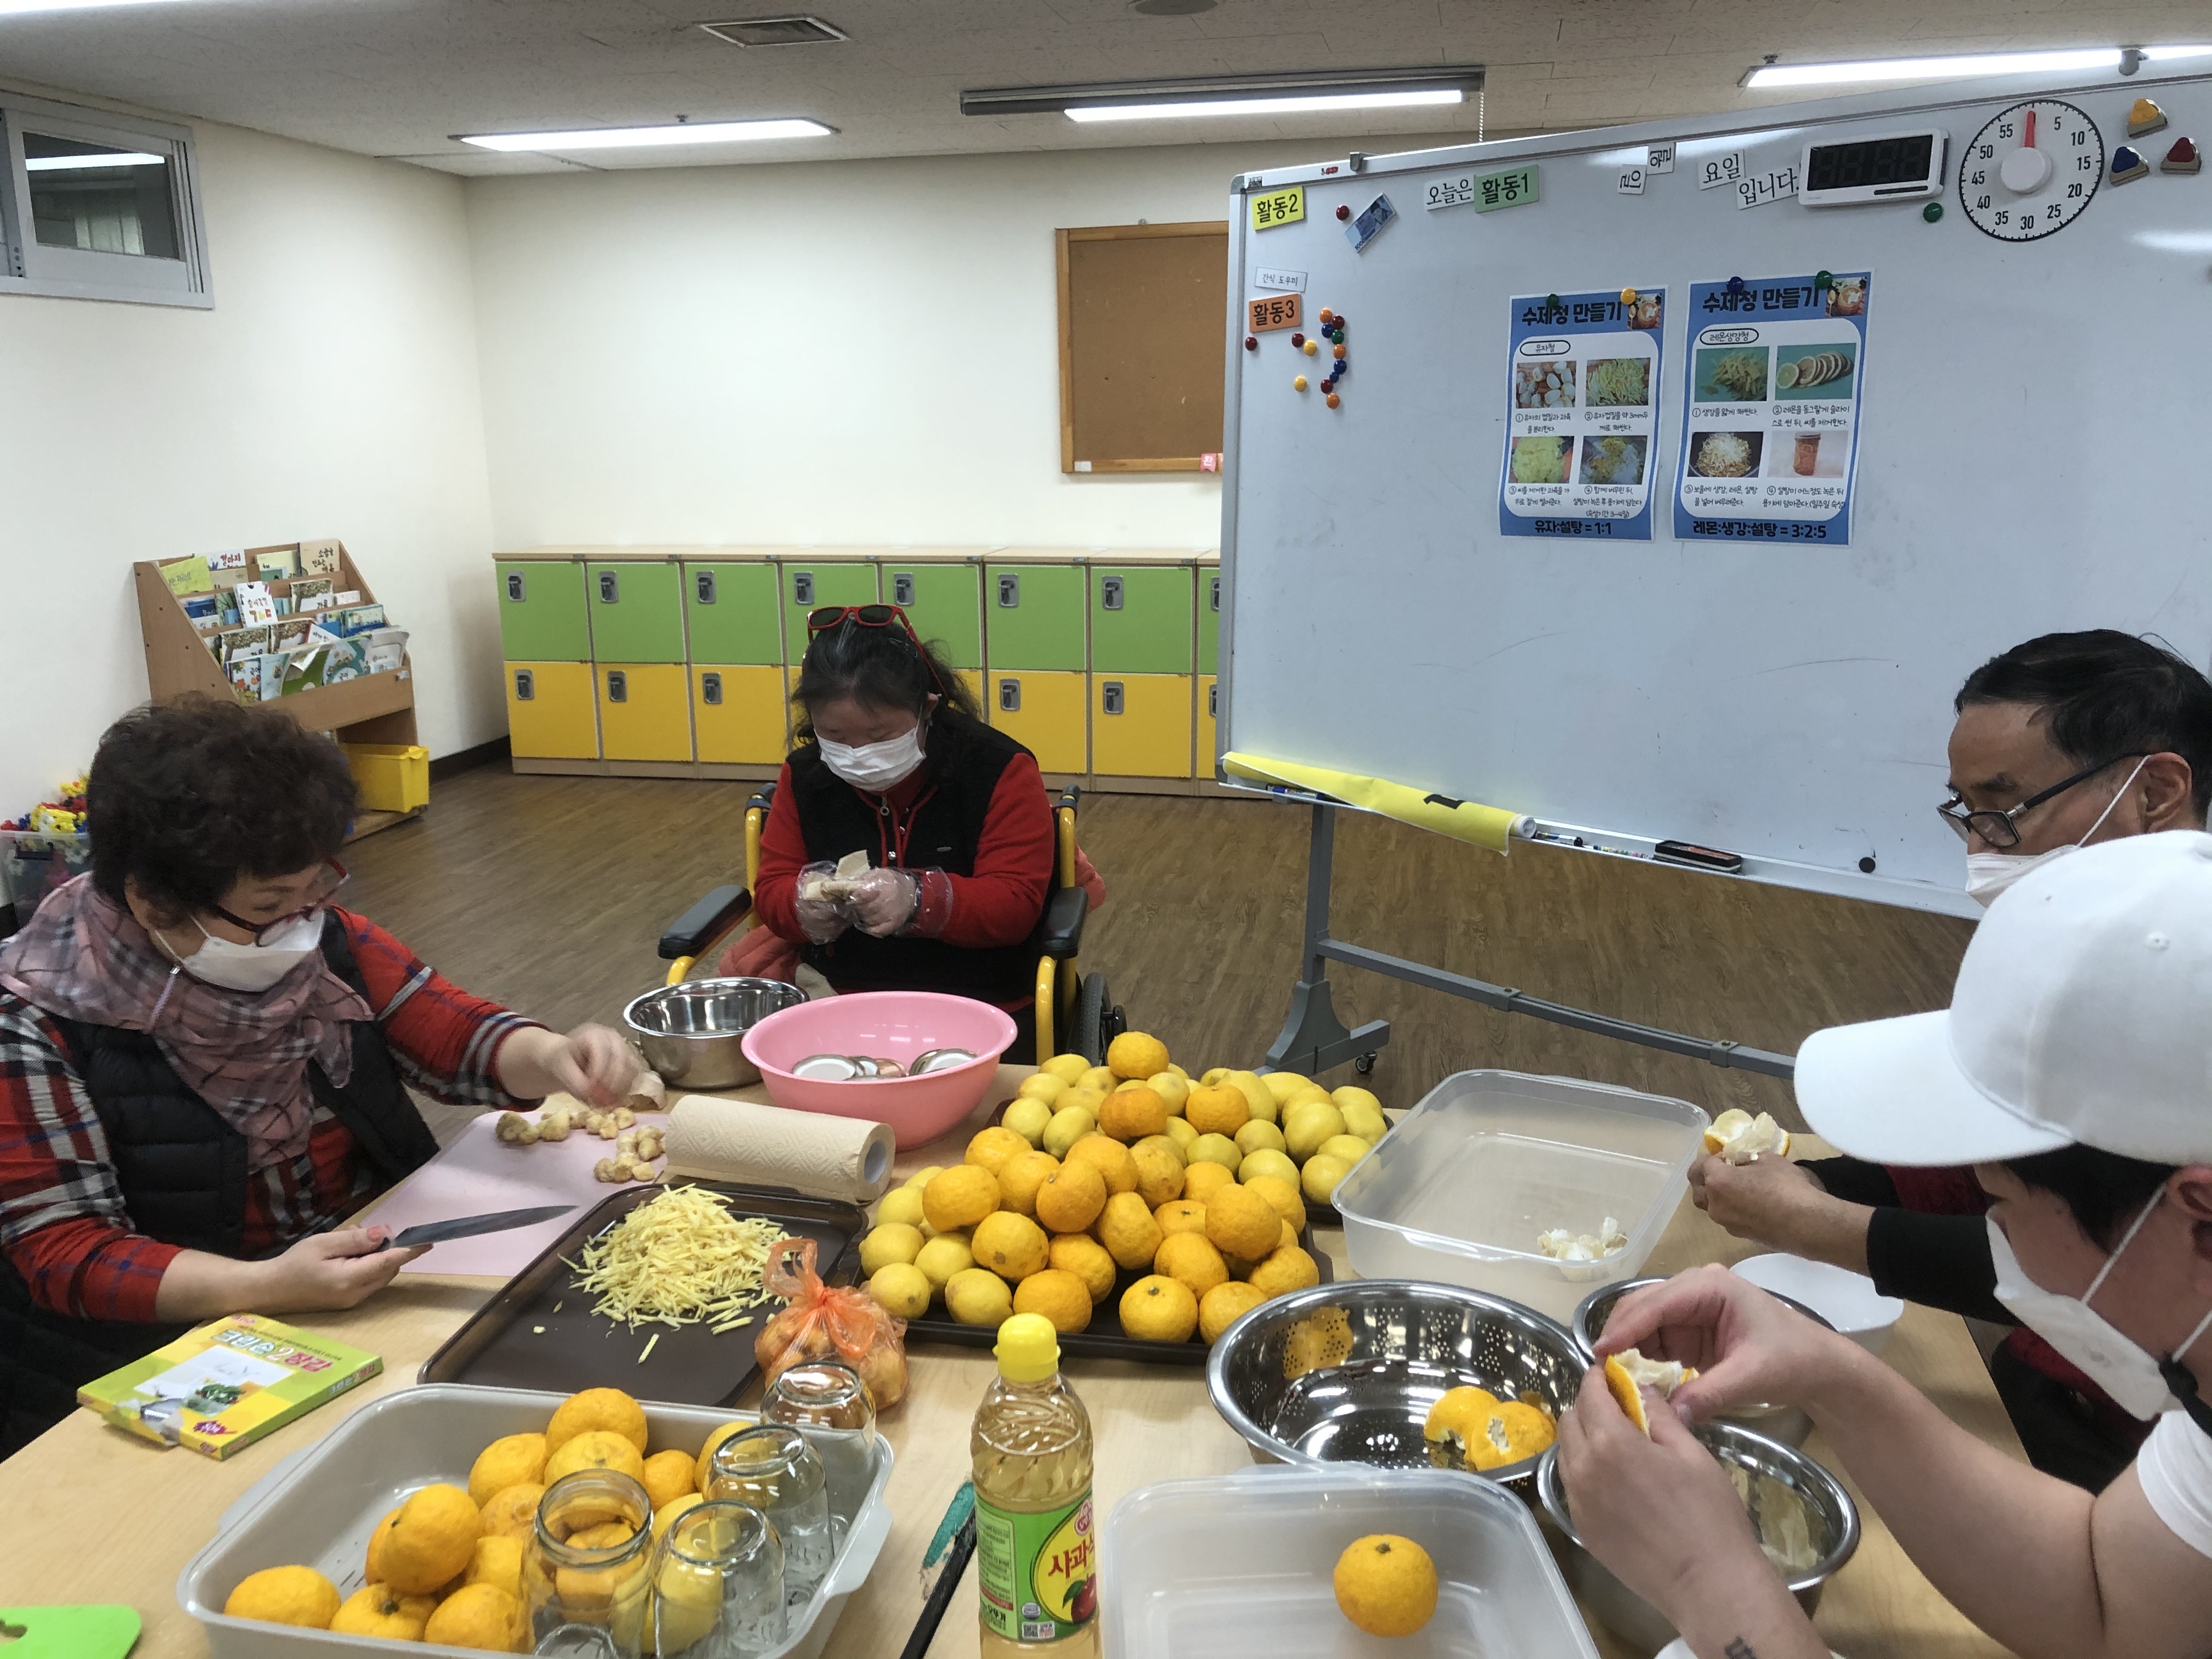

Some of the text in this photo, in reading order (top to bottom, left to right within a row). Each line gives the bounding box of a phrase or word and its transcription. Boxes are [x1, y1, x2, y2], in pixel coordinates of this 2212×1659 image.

[1999, 123, 2013, 138] 55
[2054, 116, 2061, 131] 5
[2070, 131, 2085, 146] 10
[1979, 144, 1993, 159] 50
[1703, 153, 1741, 184] 요일
[2077, 156, 2091, 171] 15
[1620, 170, 1641, 188] 일
[1972, 171, 1985, 185] 45
[1426, 179, 1472, 205] 오늘은
[1481, 173, 1527, 205] 활동1
[1739, 168, 1799, 205] 입니다.
[2067, 183, 2082, 198] 20
[1256, 194, 1298, 223] 활동2
[1977, 195, 1990, 210] 40
[1995, 211, 2008, 225] 35
[2047, 204, 2061, 219] 25
[2021, 215, 2034, 230] 30
[1262, 274, 1298, 286] 간식 도우미
[1703, 286, 1818, 313] 수제청 만들기
[1253, 300, 1295, 326] 활동3
[1522, 301, 1622, 326] 수제청 만들기
[1709, 331, 1750, 342] 레몬생강청
[1536, 343, 1555, 353] 유자청
[1542, 413, 1559, 421] 껍질과
[1560, 413, 1571, 421] 과육
[1702, 408, 1720, 417] 생강을
[1722, 408, 1735, 416] 얇게
[1783, 405, 1801, 415] 레몬을
[1803, 405, 1829, 415] 동그랗게
[1830, 405, 1850, 414] 슬라이
[1804, 417, 1816, 427] 씨를
[1818, 418, 1848, 427] 제거한다.
[1594, 486, 1607, 494] 함께
[1745, 486, 1758, 495] 설탕
[1778, 487, 1796, 495] 설탕이
[1823, 487, 1835, 496] 녹은
[1601, 498, 1606, 506] 후
[1607, 498, 1624, 506] 용기에
[1701, 498, 1713, 506] 넣어
[1762, 499, 1782, 507] 용기에
[1534, 520, 1582, 533] 유자:설탕
[1594, 522, 1612, 535] 1:1
[1693, 520, 1778, 537] 레몬:생강:설탕
[1791, 523, 1826, 538] 3:2:5
